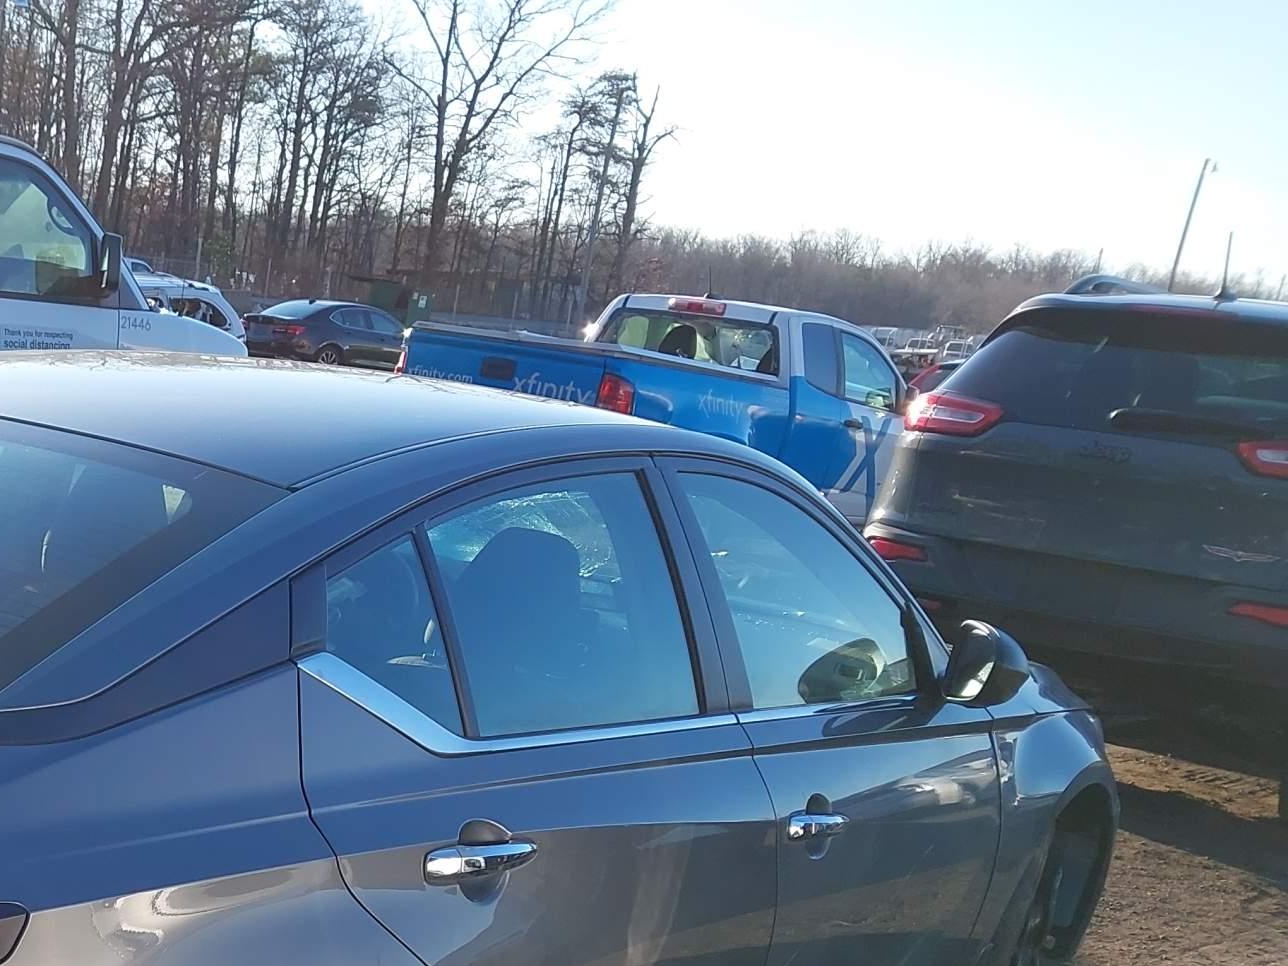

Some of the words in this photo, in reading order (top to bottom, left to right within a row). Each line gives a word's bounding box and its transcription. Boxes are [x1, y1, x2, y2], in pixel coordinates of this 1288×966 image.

[120, 316, 152, 331] 21446
[4, 328, 22, 337] Thank
[22, 330, 34, 338] you
[35, 330, 44, 338] for
[44, 332, 73, 340] respecting
[3, 339, 28, 349] social
[513, 372, 596, 403] xfinity
[697, 388, 743, 425] xfinity
